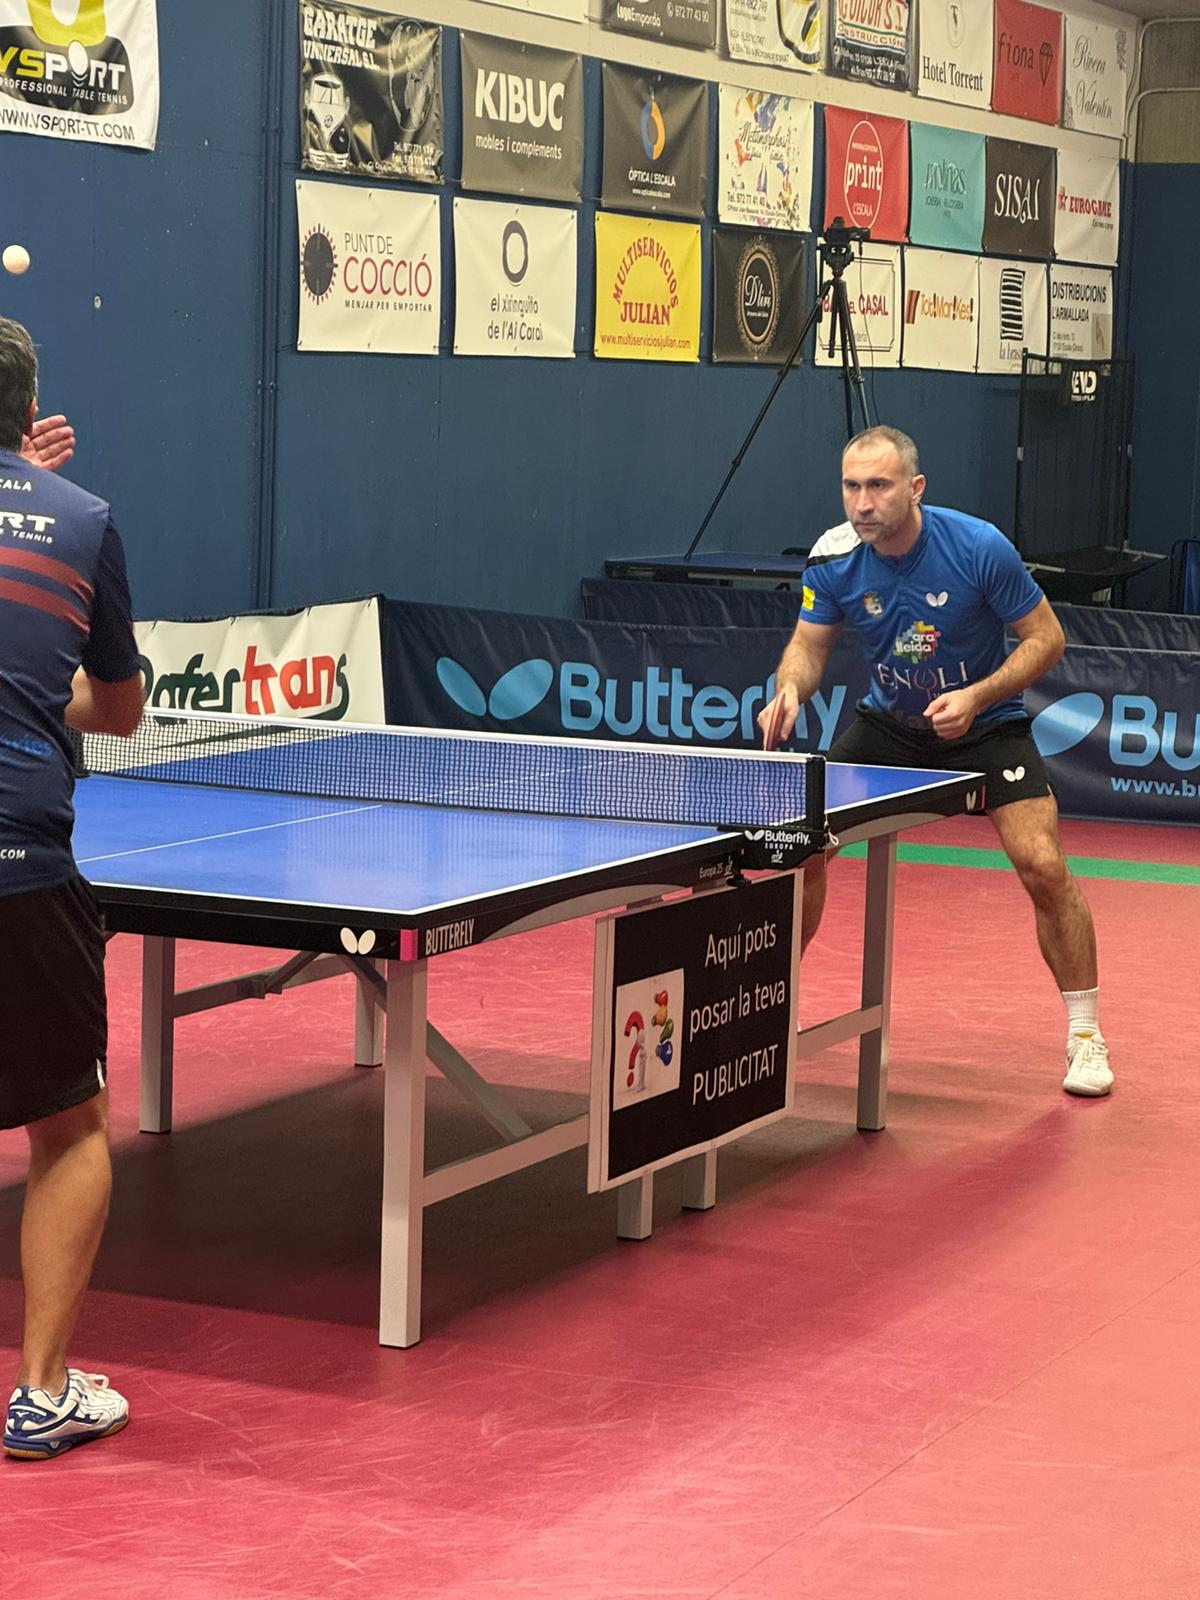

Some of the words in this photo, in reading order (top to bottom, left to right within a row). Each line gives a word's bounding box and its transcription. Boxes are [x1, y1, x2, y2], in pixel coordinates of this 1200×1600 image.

[304, 6, 377, 49] GARATGE
[998, 32, 1034, 69] fiona
[922, 56, 947, 84] Hotel
[948, 62, 984, 92] Torrent
[71, 87, 95, 100] TABLE
[97, 92, 128, 105] TENNIS
[475, 68, 565, 131] KIBUC
[475, 133, 505, 152] mobles
[506, 135, 511, 153] i
[511, 140, 562, 160] complements
[845, 155, 882, 194] print
[344, 232, 374, 253] PUNT
[376, 235, 393, 255] DE
[343, 252, 433, 298] COCCIÓ
[612, 236, 679, 309] MULTISERVICIOS
[490, 291, 500, 313] el
[1052, 281, 1107, 303] DISTRIBUCIONS
[344, 299, 374, 311] MENJAR
[376, 301, 390, 311] PER
[393, 302, 433, 313] EMPORTAR
[620, 301, 671, 326] JULIAN
[859, 294, 889, 317] CASAL
[1051, 306, 1090, 323] L'ARMALLADA
[487, 320, 500, 340] de
[12, 530, 53, 544] TENNIS
[896, 640, 932, 653] lleida
[912, 633, 936, 642] ara
[764, 828, 811, 845] Butterfly
[764, 842, 793, 850] EUROPA
[425, 917, 475, 956] BUTTERFLY
[705, 923, 742, 970] Aquí
[744, 920, 777, 963] pots
[689, 996, 736, 1043] posar
[738, 984, 751, 1017] la
[754, 979, 786, 1012] teva
[692, 1044, 778, 1106] PUBLICITAT
